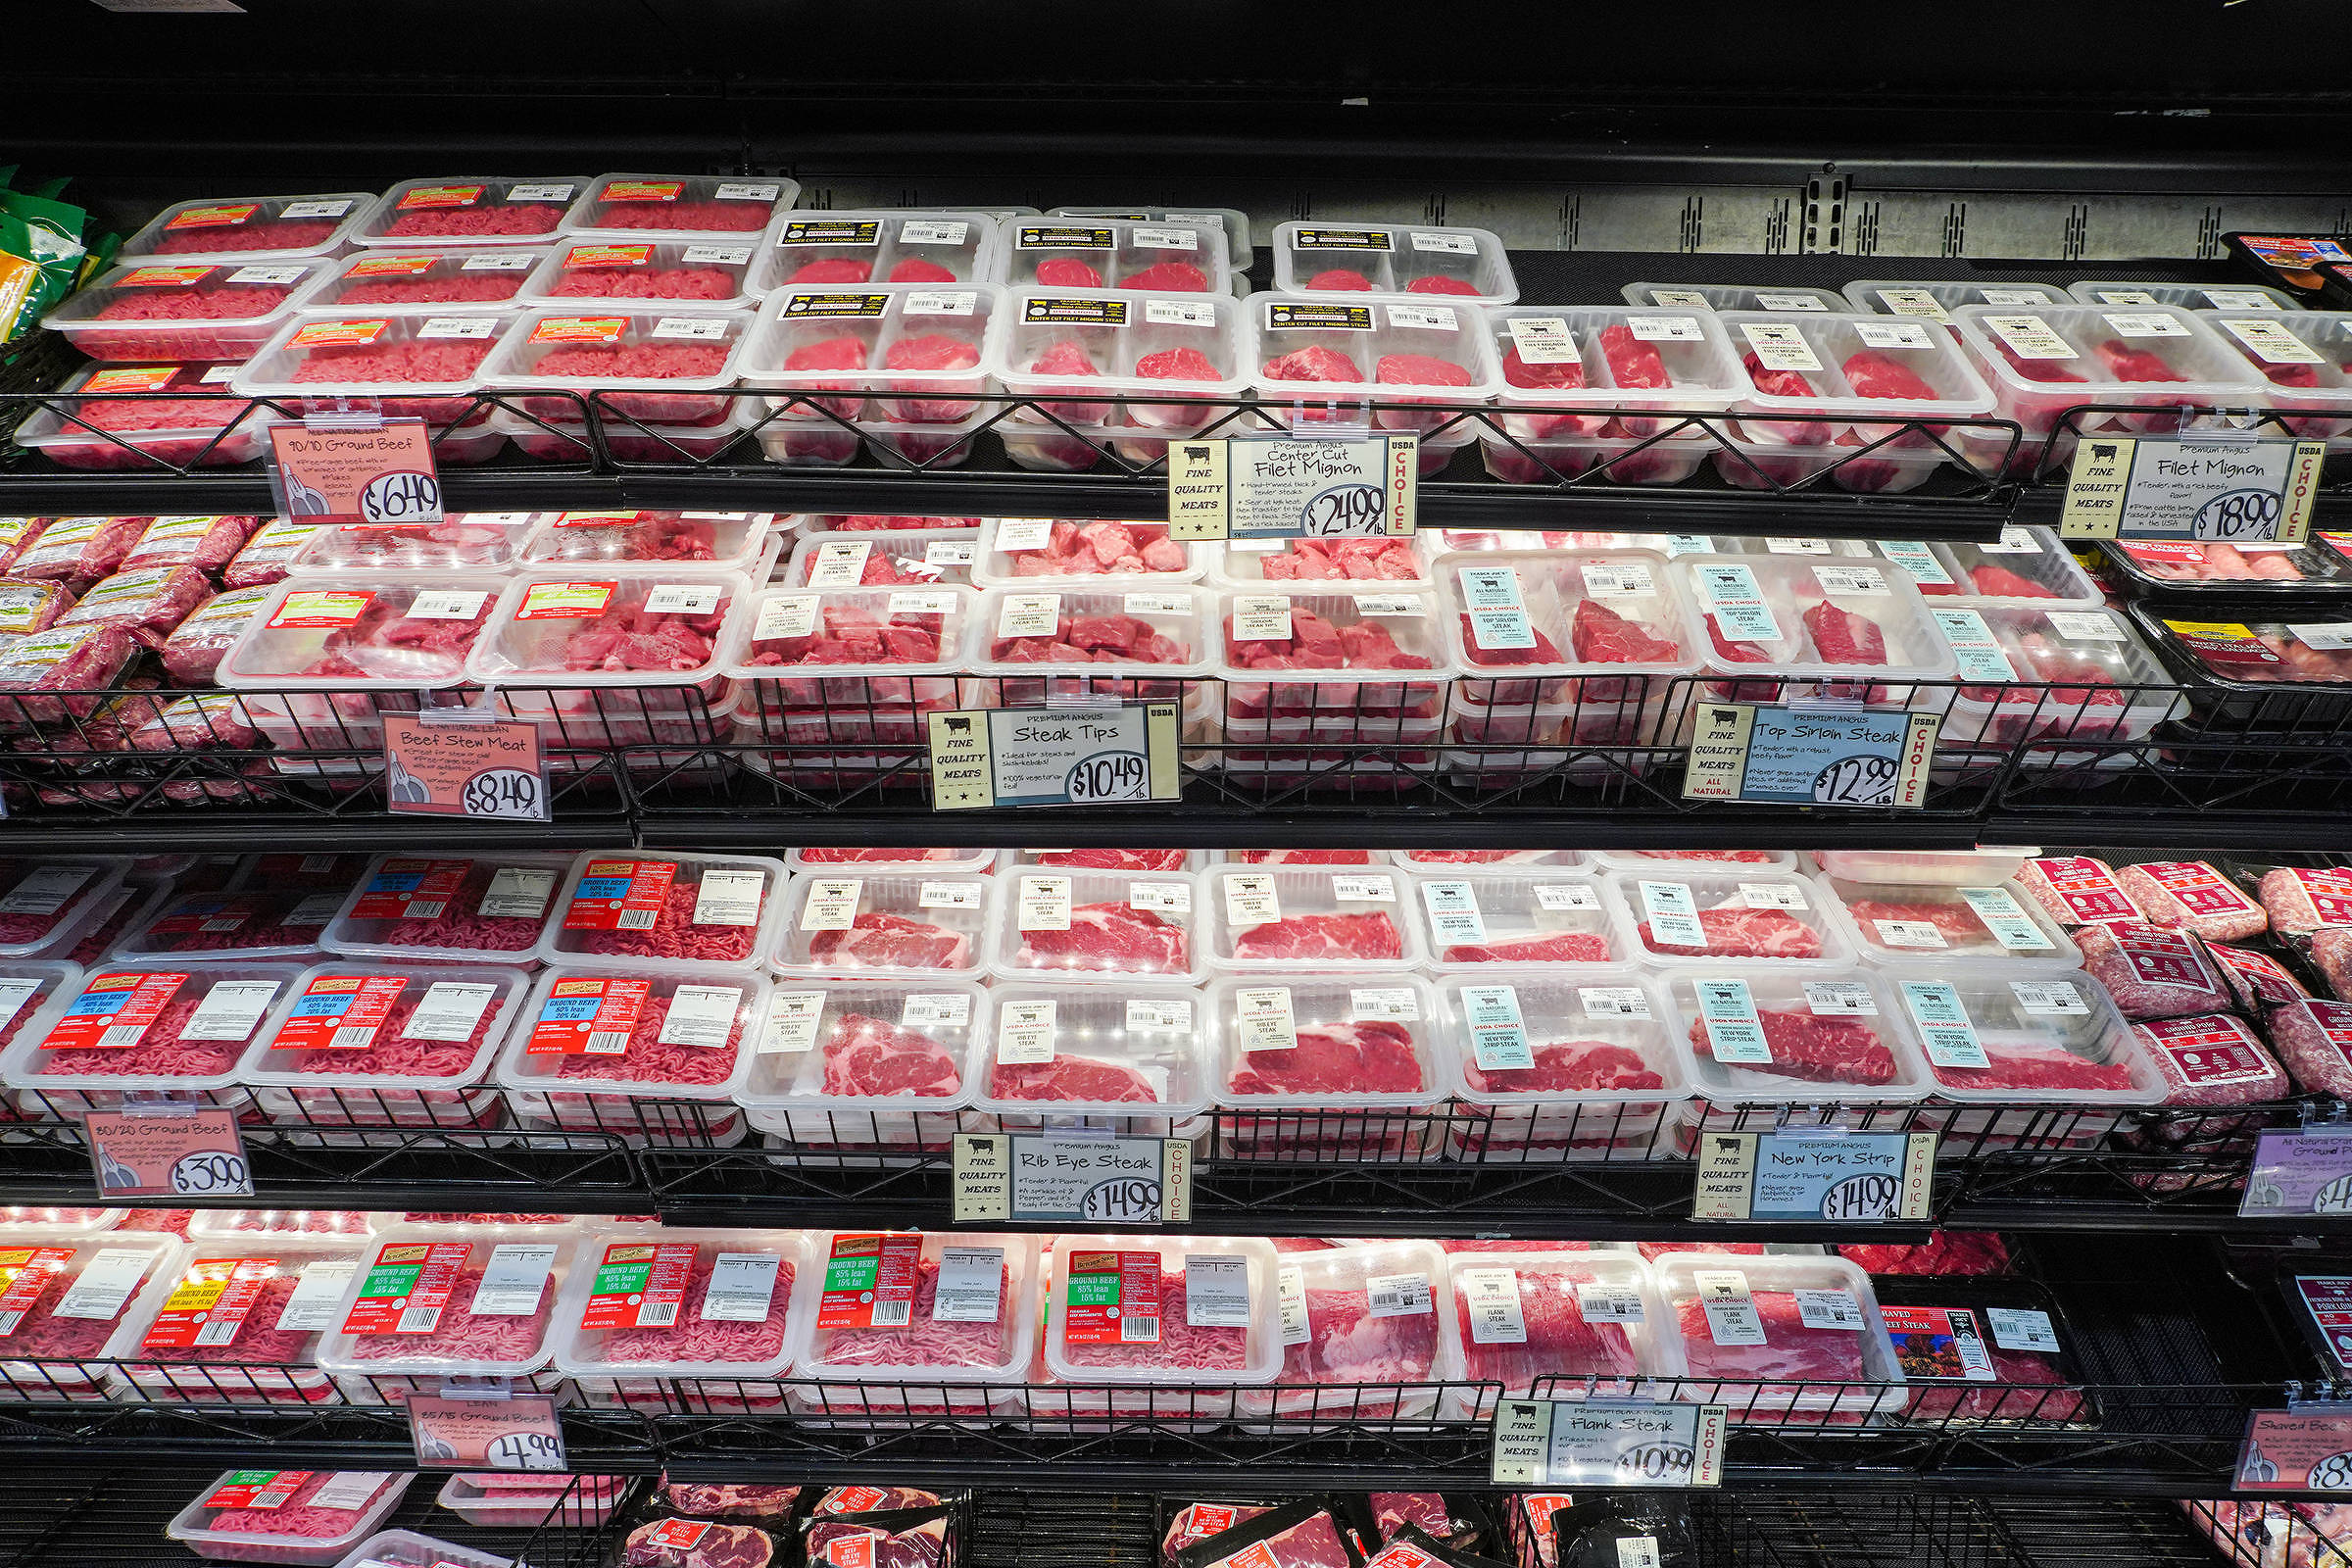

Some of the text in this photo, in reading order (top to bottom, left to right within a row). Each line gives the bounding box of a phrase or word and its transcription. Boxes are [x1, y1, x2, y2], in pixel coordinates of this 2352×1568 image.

[289, 438, 413, 452] 90/10 Ground Beef
[1273, 441, 1314, 450] Premium
[2180, 445, 2250, 455] Premium Angus
[1267, 450, 1348, 462] Center Cut
[2298, 447, 2321, 456] USDA
[1254, 461, 1362, 478] Filet Mignon
[2158, 460, 2265, 478] Filet Mignon
[1175, 485, 1223, 495] QUALITY
[1395, 453, 1406, 529] CHOICE
[2073, 483, 2122, 492] QUALITY
[2075, 500, 2114, 509] MEATS
[2287, 460, 2313, 537] CHOICE
[1181, 501, 1218, 510] MEATS
[1027, 713, 1070, 722] PREMIUM
[1014, 725, 1119, 743] Steak Tips
[1756, 723, 1900, 744] Top Sirloin Steak
[400, 732, 526, 751] Beef Stew Meat
[1694, 746, 1743, 756] QUALITY
[937, 755, 987, 763] QUALITY
[1905, 729, 1929, 802] CHOICE
[1693, 787, 1731, 796] NATURAL
[2165, 1024, 2196, 1033] GROUND
[97, 1124, 227, 1135] 80/20 Ground Beef
[2293, 1147, 2337, 1156] Ground
[1020, 1153, 1152, 1170] Rib Eye Steak
[1772, 1152, 1895, 1167] New York Strip
[1171, 1151, 1182, 1219] CHOICE
[1910, 1151, 1923, 1215] CHOICE
[829, 1259, 877, 1269] GROUND BEEF
[461, 1411, 510, 1421] Ground
[512, 1413, 548, 1424] Beef
[1571, 1419, 1674, 1432] Flank Steak
[2258, 1420, 2306, 1430] Shaved
[1702, 1419, 1716, 1480] CHOICE
